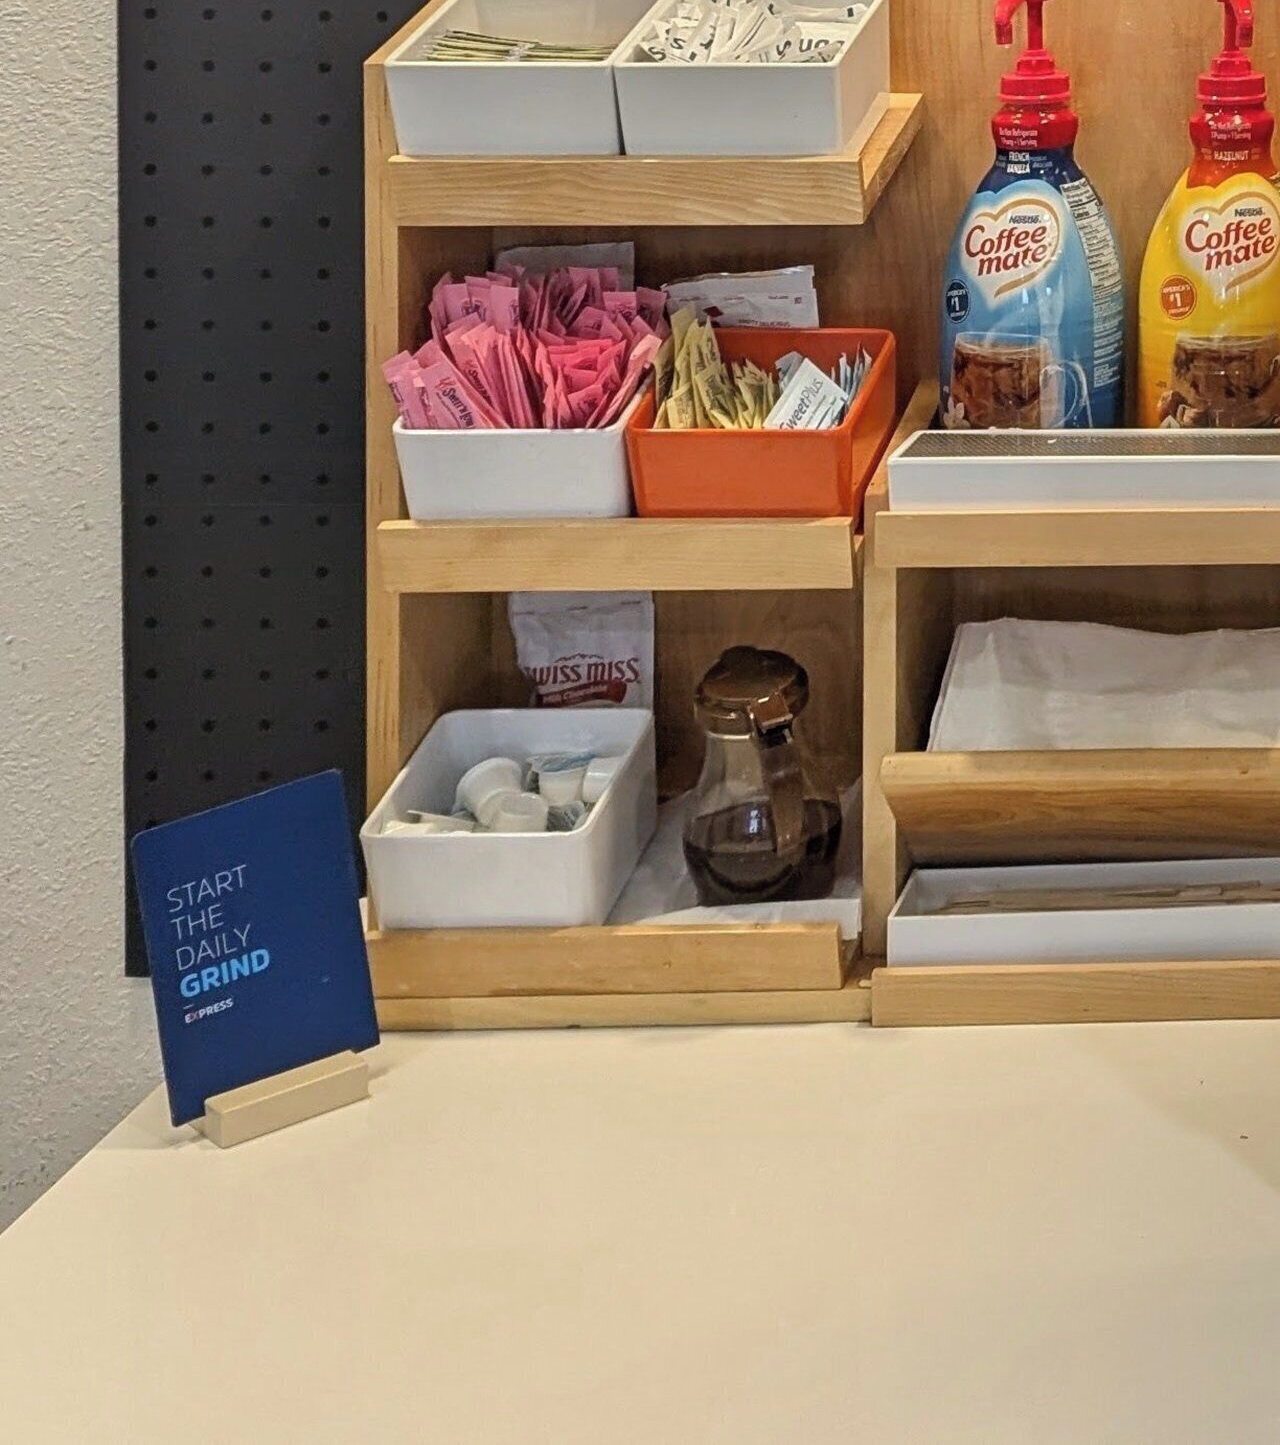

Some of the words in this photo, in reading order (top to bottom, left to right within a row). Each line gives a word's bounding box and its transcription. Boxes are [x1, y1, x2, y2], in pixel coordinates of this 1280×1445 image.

[1214, 150, 1249, 161] HAZELNUT
[964, 224, 1048, 258] Coffee
[1185, 217, 1272, 253] Coffee
[1205, 234, 1275, 271] mate
[977, 244, 1048, 276] mate
[166, 863, 247, 913] START
[170, 903, 225, 941] THE
[176, 923, 251, 972] DAILY
[179, 947, 270, 998] GRIND
[184, 997, 234, 1024] EXPRESS
